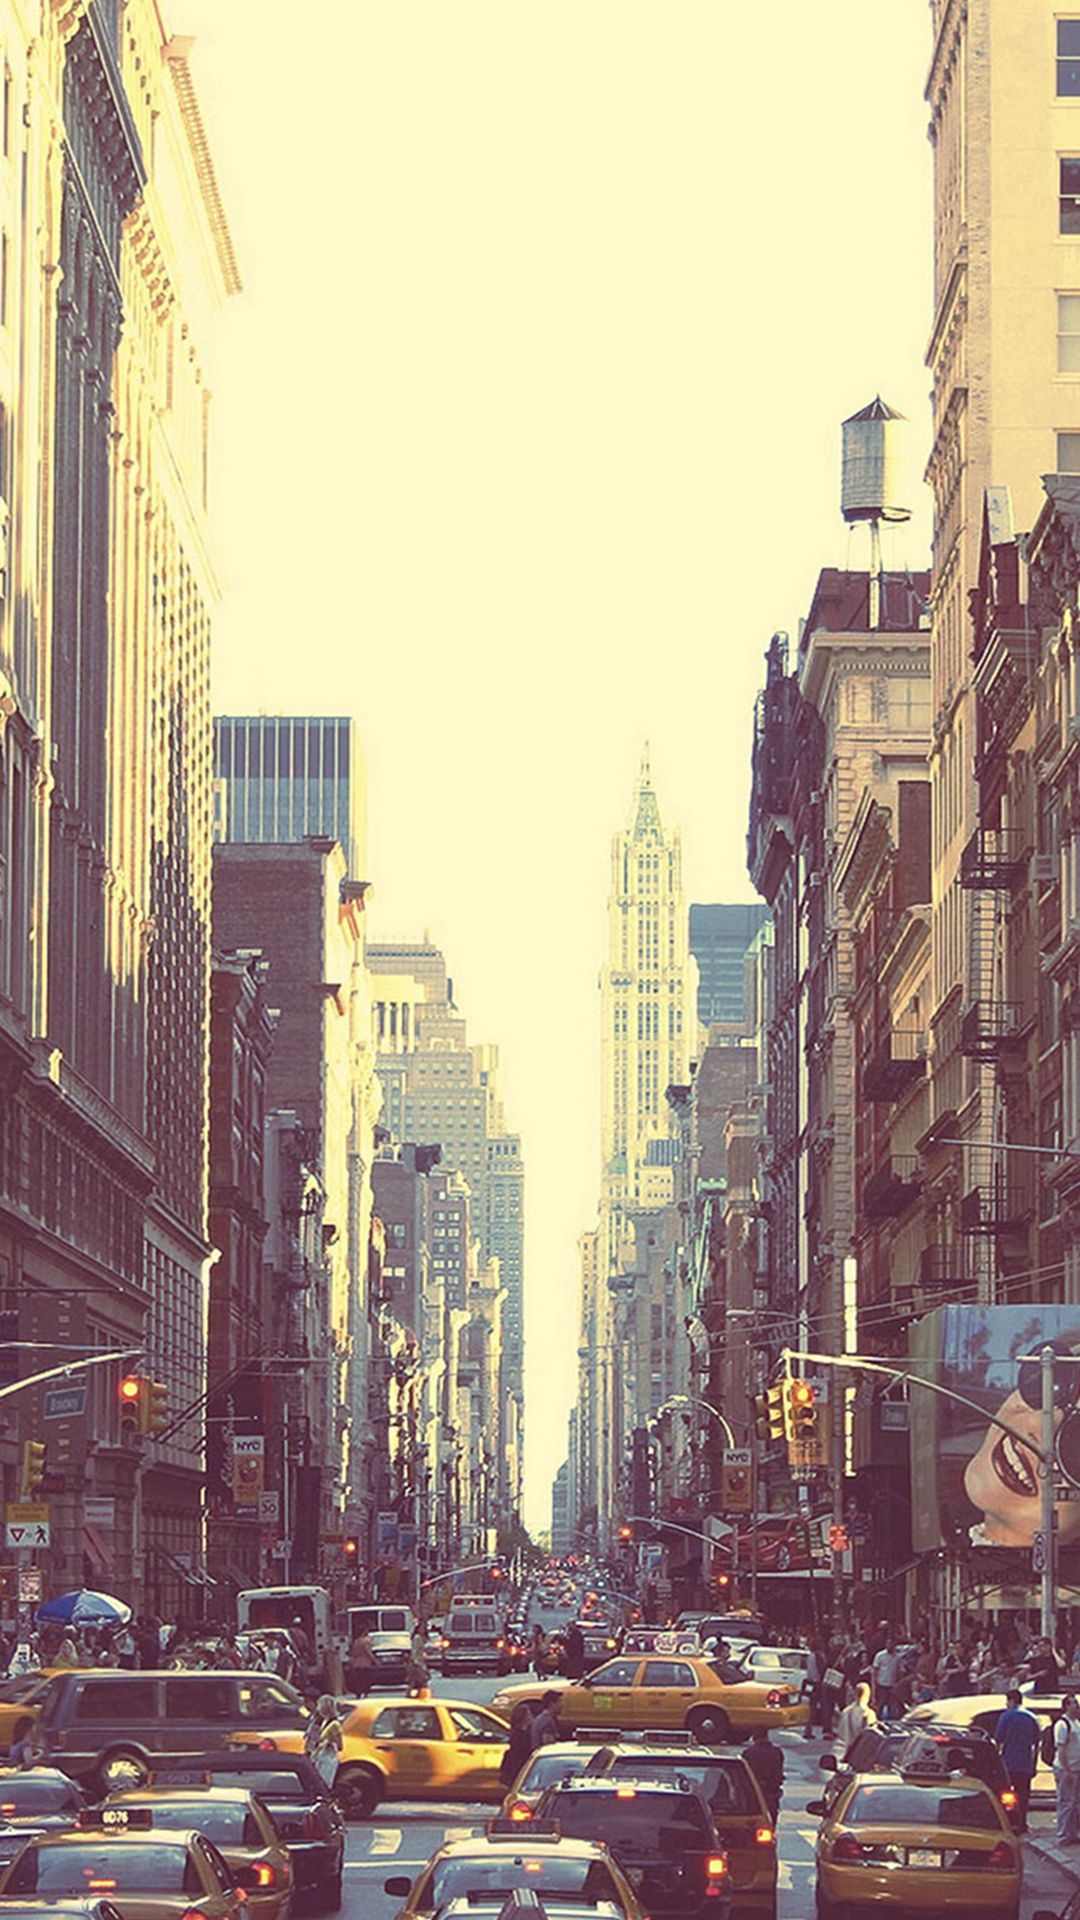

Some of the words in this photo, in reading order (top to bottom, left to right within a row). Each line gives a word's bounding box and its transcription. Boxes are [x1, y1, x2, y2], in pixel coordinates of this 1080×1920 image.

[236, 1441, 260, 1451] NYC
[726, 1452, 748, 1462] NYC
[261, 1503, 277, 1514] 30
